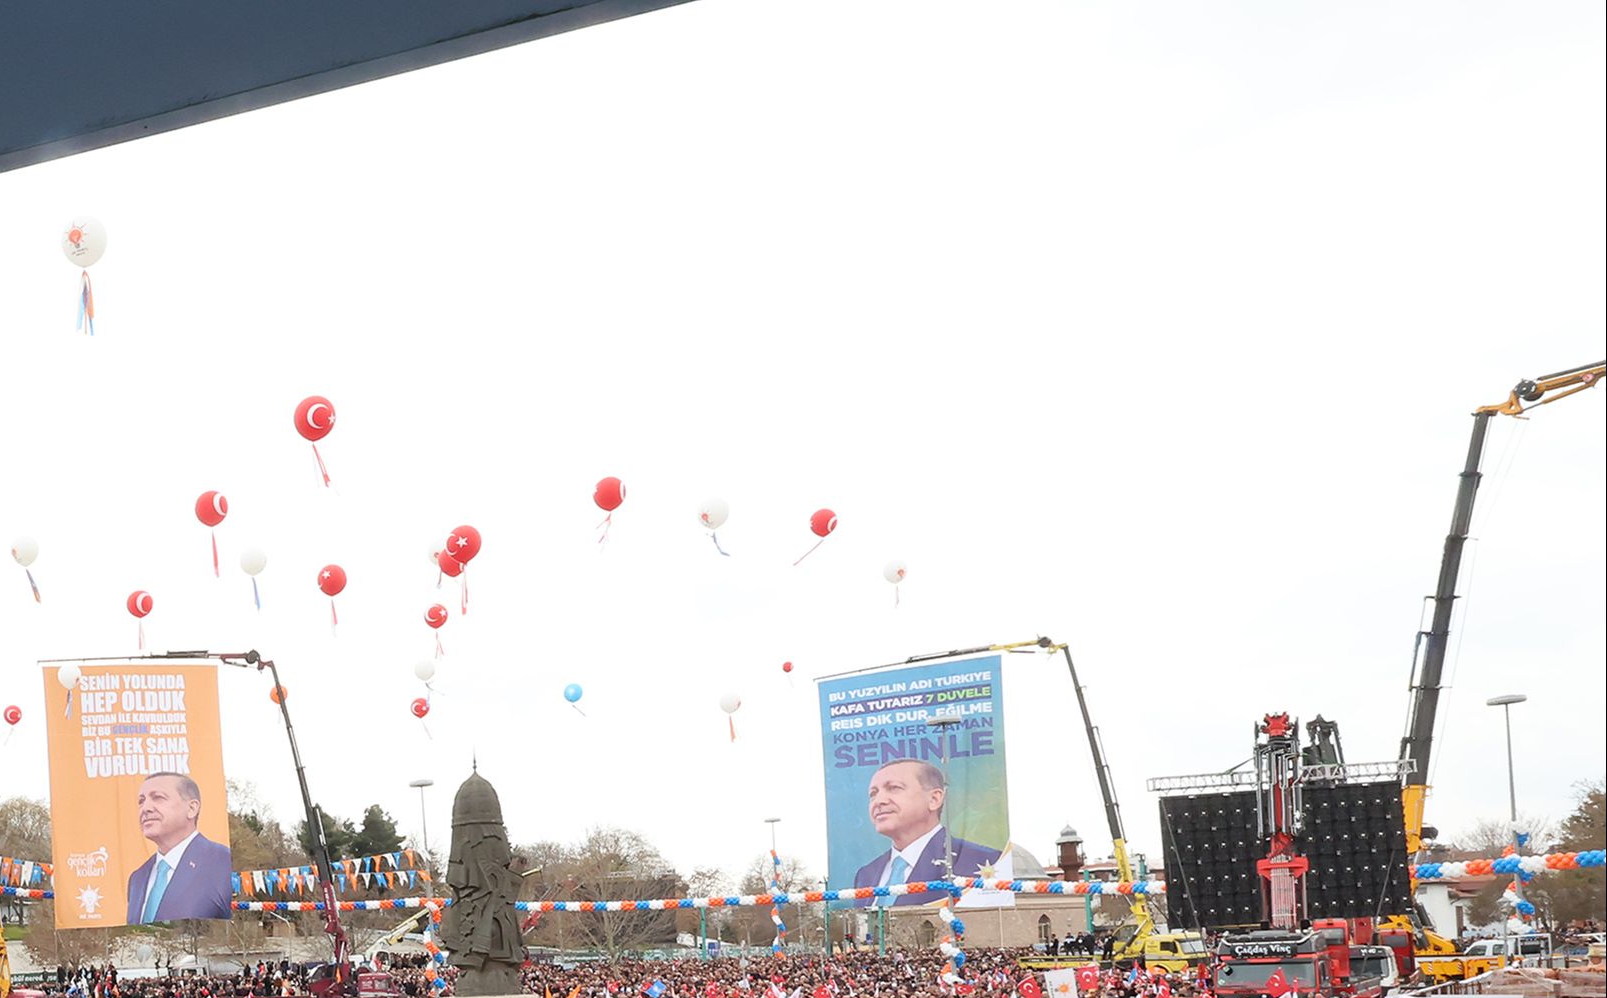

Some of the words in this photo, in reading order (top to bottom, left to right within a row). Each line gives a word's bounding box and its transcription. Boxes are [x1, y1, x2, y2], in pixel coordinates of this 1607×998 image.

[80, 672, 120, 691] SENİN
[122, 674, 186, 690] YOLUNDA
[829, 691, 845, 703] BU
[909, 680, 932, 691] ADI
[81, 691, 118, 713] HEP
[121, 690, 186, 712] OLDUK
[830, 704, 865, 716] KAFA
[867, 695, 923, 711] TUTARIZ
[926, 694, 934, 704] 7
[833, 728, 889, 744] KONYA
[894, 724, 927, 737] HER
[84, 737, 112, 757] BİR
[115, 737, 143, 754] TEK
[145, 737, 189, 754] SANA
[85, 754, 190, 778] VURULDUK
[1234, 945, 1268, 956] Çağdaş
